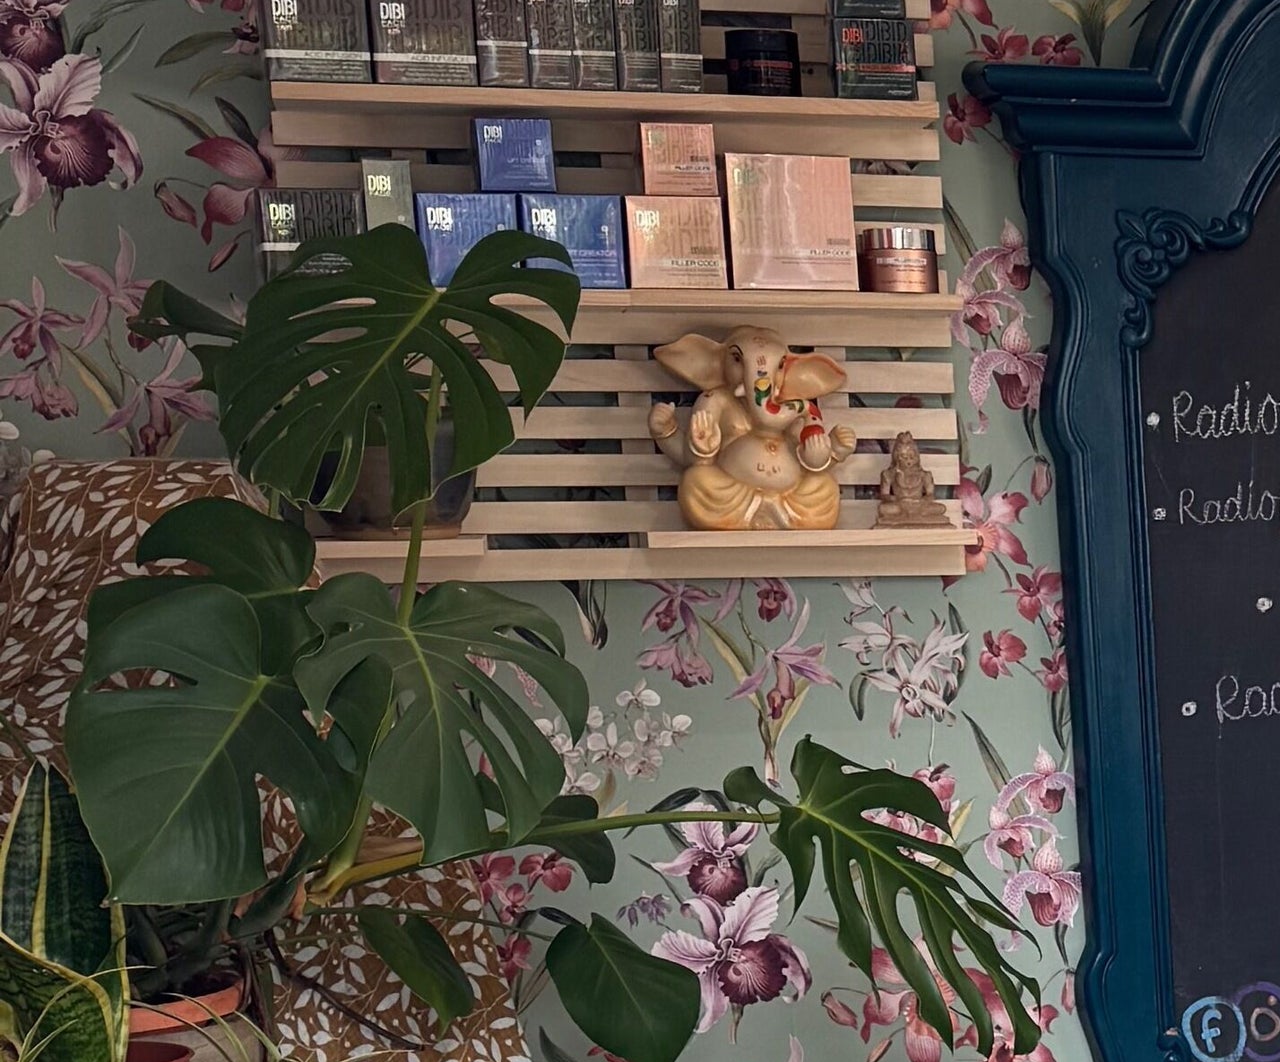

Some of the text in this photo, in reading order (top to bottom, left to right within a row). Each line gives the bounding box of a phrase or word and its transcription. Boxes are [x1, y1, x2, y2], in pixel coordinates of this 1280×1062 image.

[272, 0, 297, 16] DIBI
[380, 2, 405, 20] DIBI
[842, 28, 864, 42] DIBI
[483, 125, 502, 138] DIBI
[368, 175, 391, 191] DIBI
[270, 203, 295, 220] DIBI
[426, 207, 453, 225] DIBI
[531, 208, 557, 226] DIBI
[636, 210, 659, 229] DIBI
